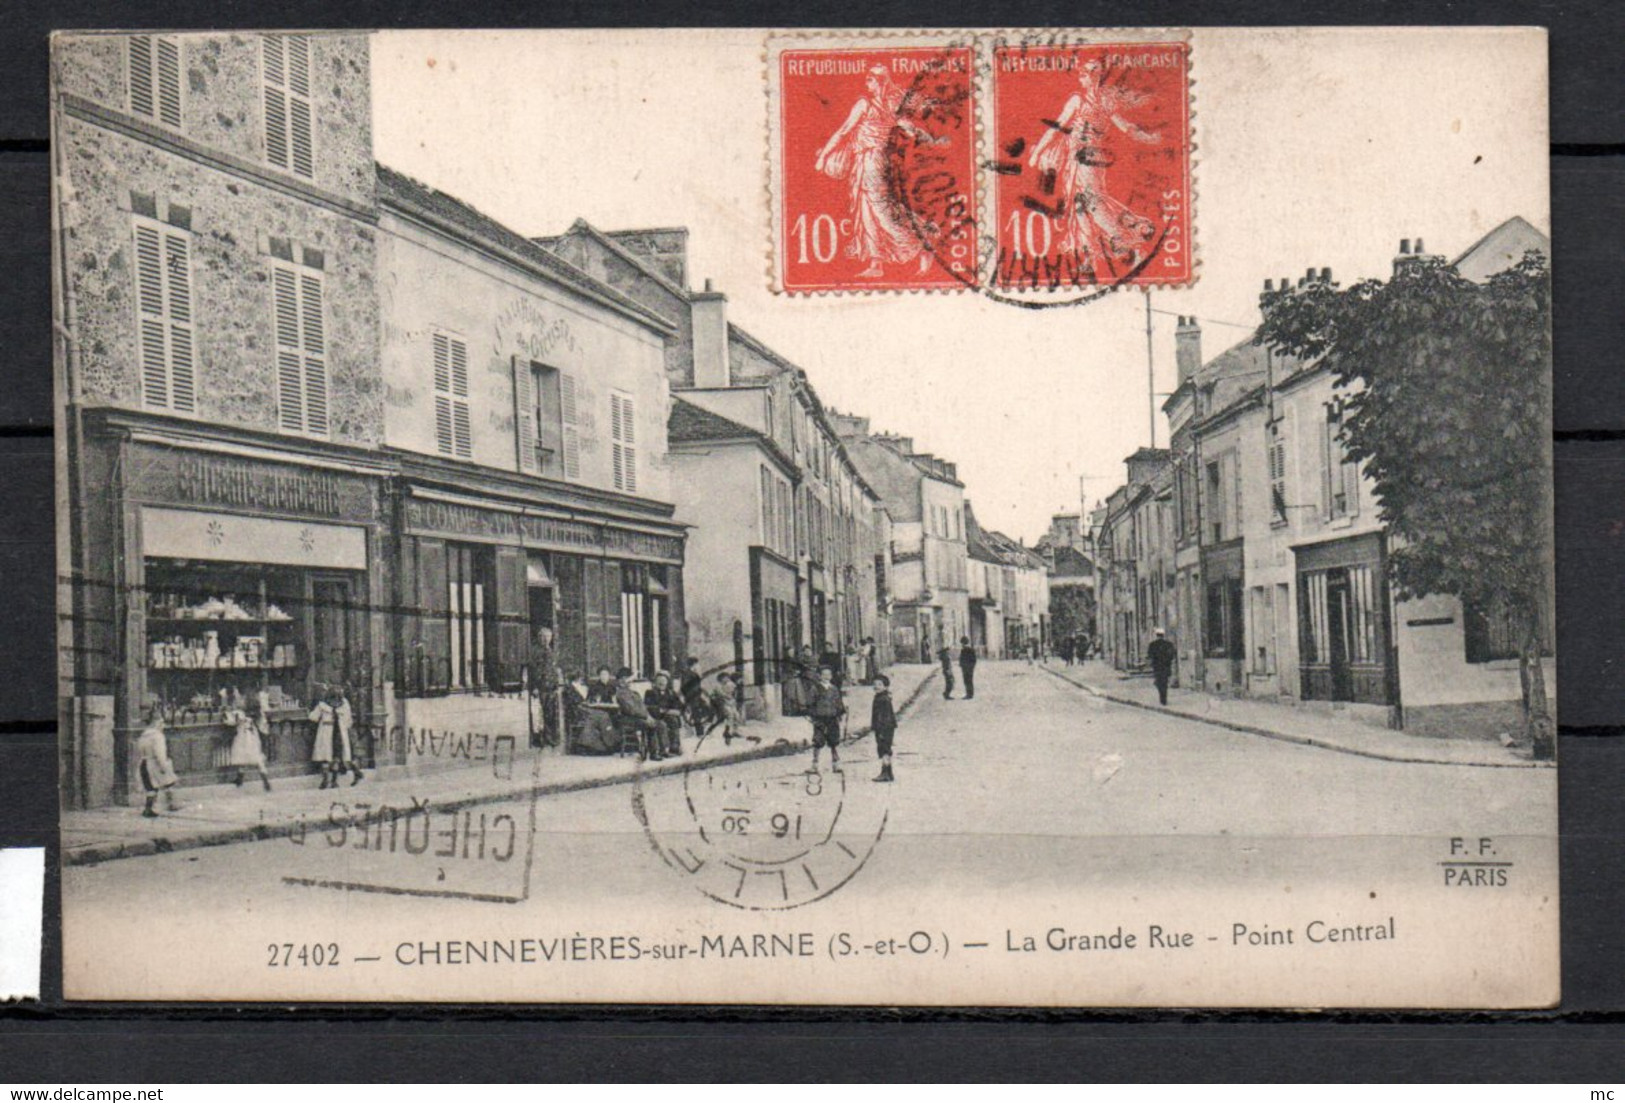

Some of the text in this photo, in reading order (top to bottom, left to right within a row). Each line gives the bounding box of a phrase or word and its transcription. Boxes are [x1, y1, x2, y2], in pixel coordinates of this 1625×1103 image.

[949, 194, 969, 273] POSTES
[1163, 188, 1182, 268] POSTES
[770, 812, 802, 841] 16
